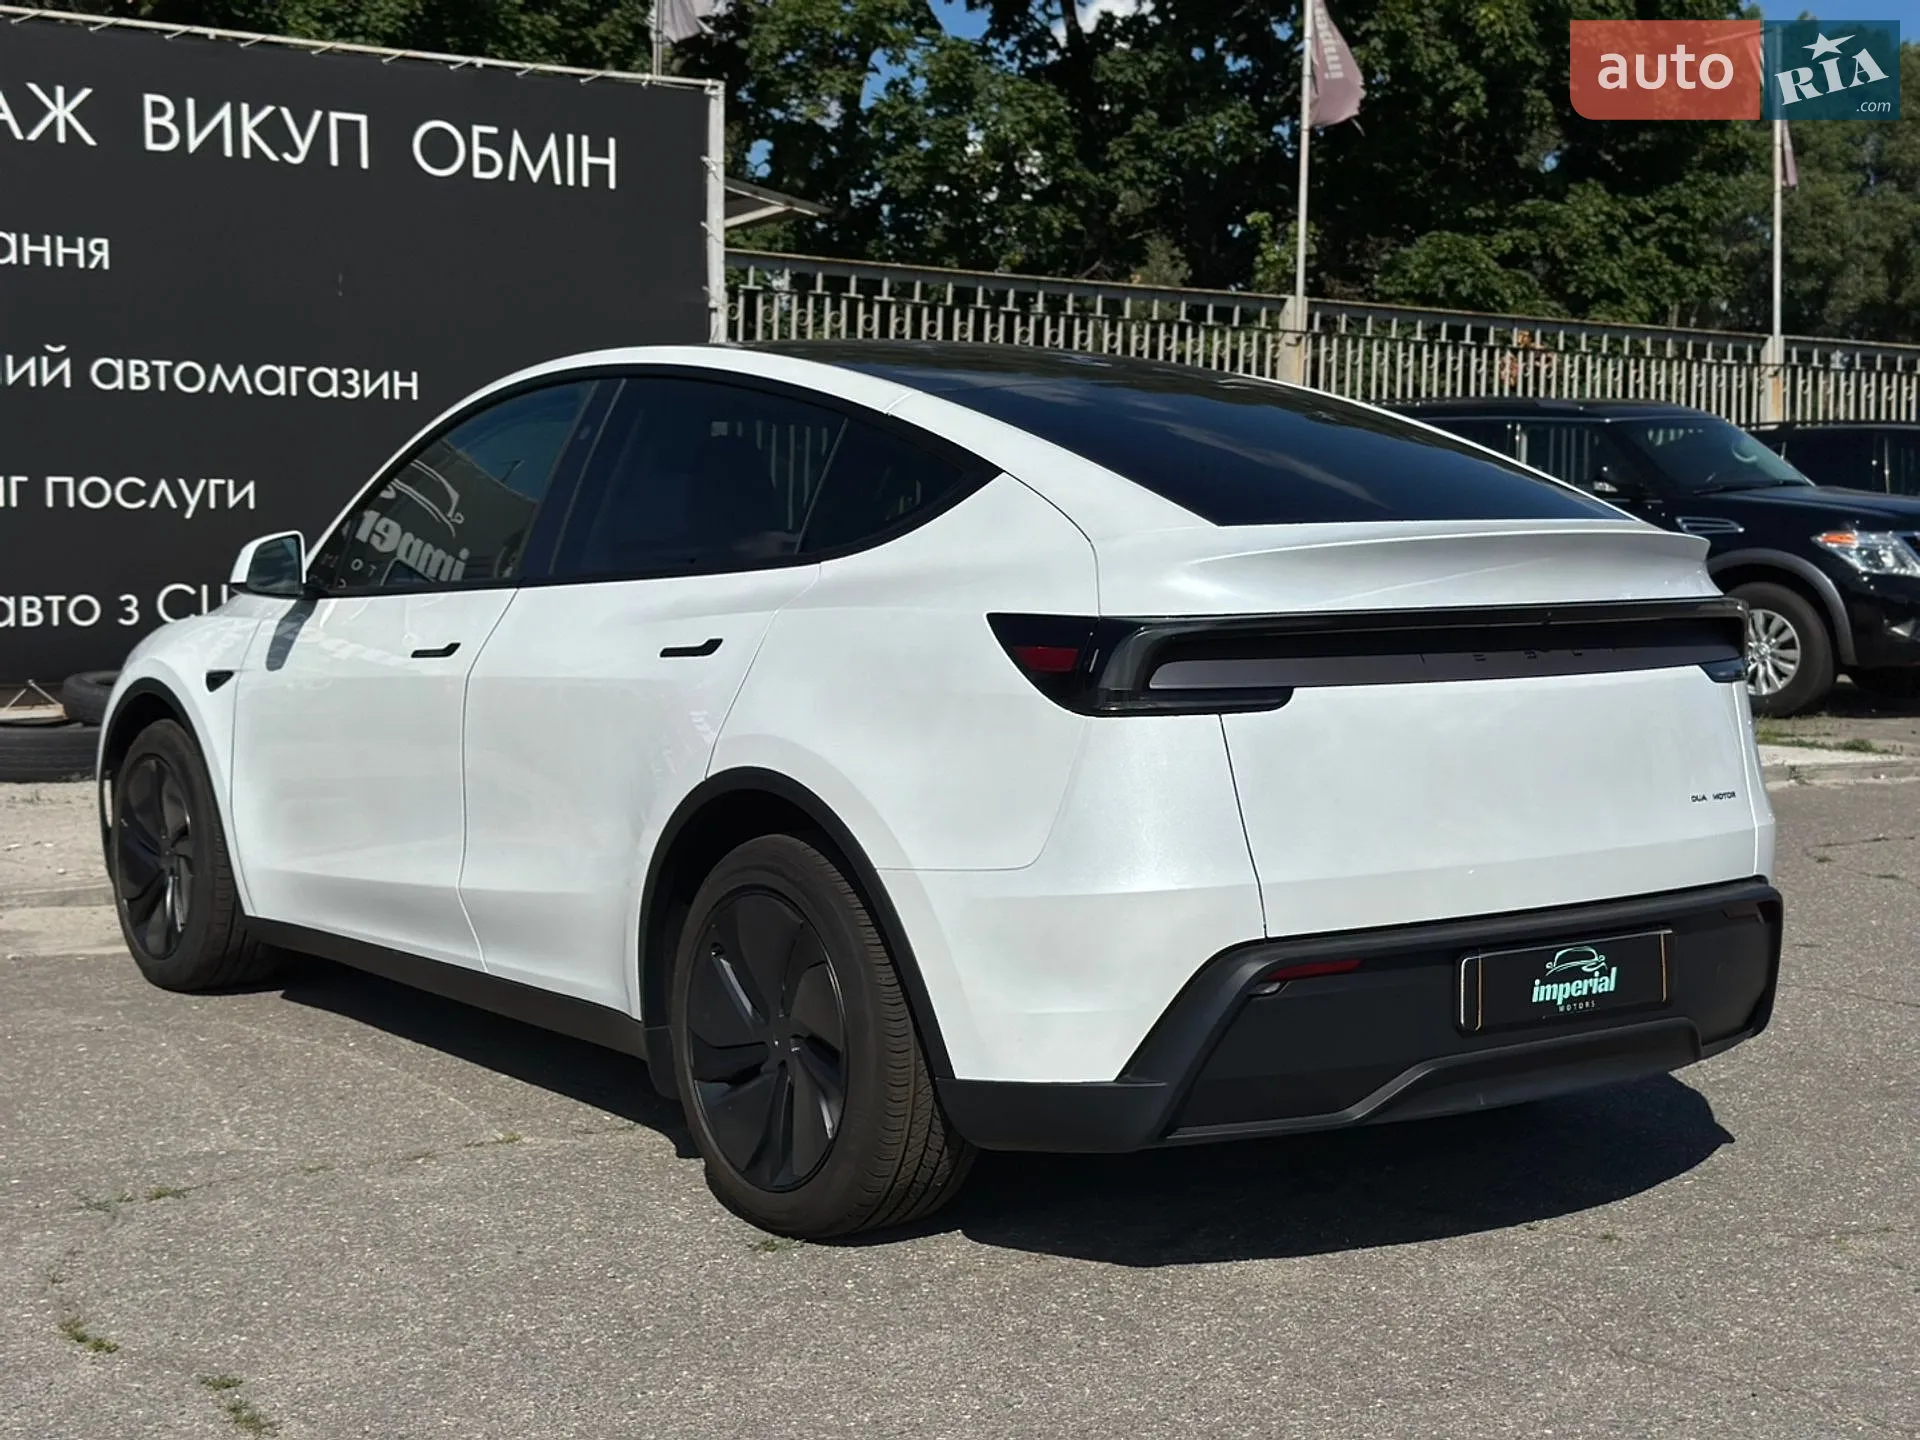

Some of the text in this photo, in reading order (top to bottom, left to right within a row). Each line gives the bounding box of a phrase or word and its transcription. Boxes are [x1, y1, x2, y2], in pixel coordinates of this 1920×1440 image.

[143, 93, 369, 169] ВИКУП
[412, 119, 617, 189] ОБМІН
[0, 343, 418, 400] ий автомагазин
[45, 475, 256, 519] послуги
[117, 593, 140, 626] з
[1531, 966, 1617, 1005] imperial
[1559, 1000, 1595, 1012] MOTORS
